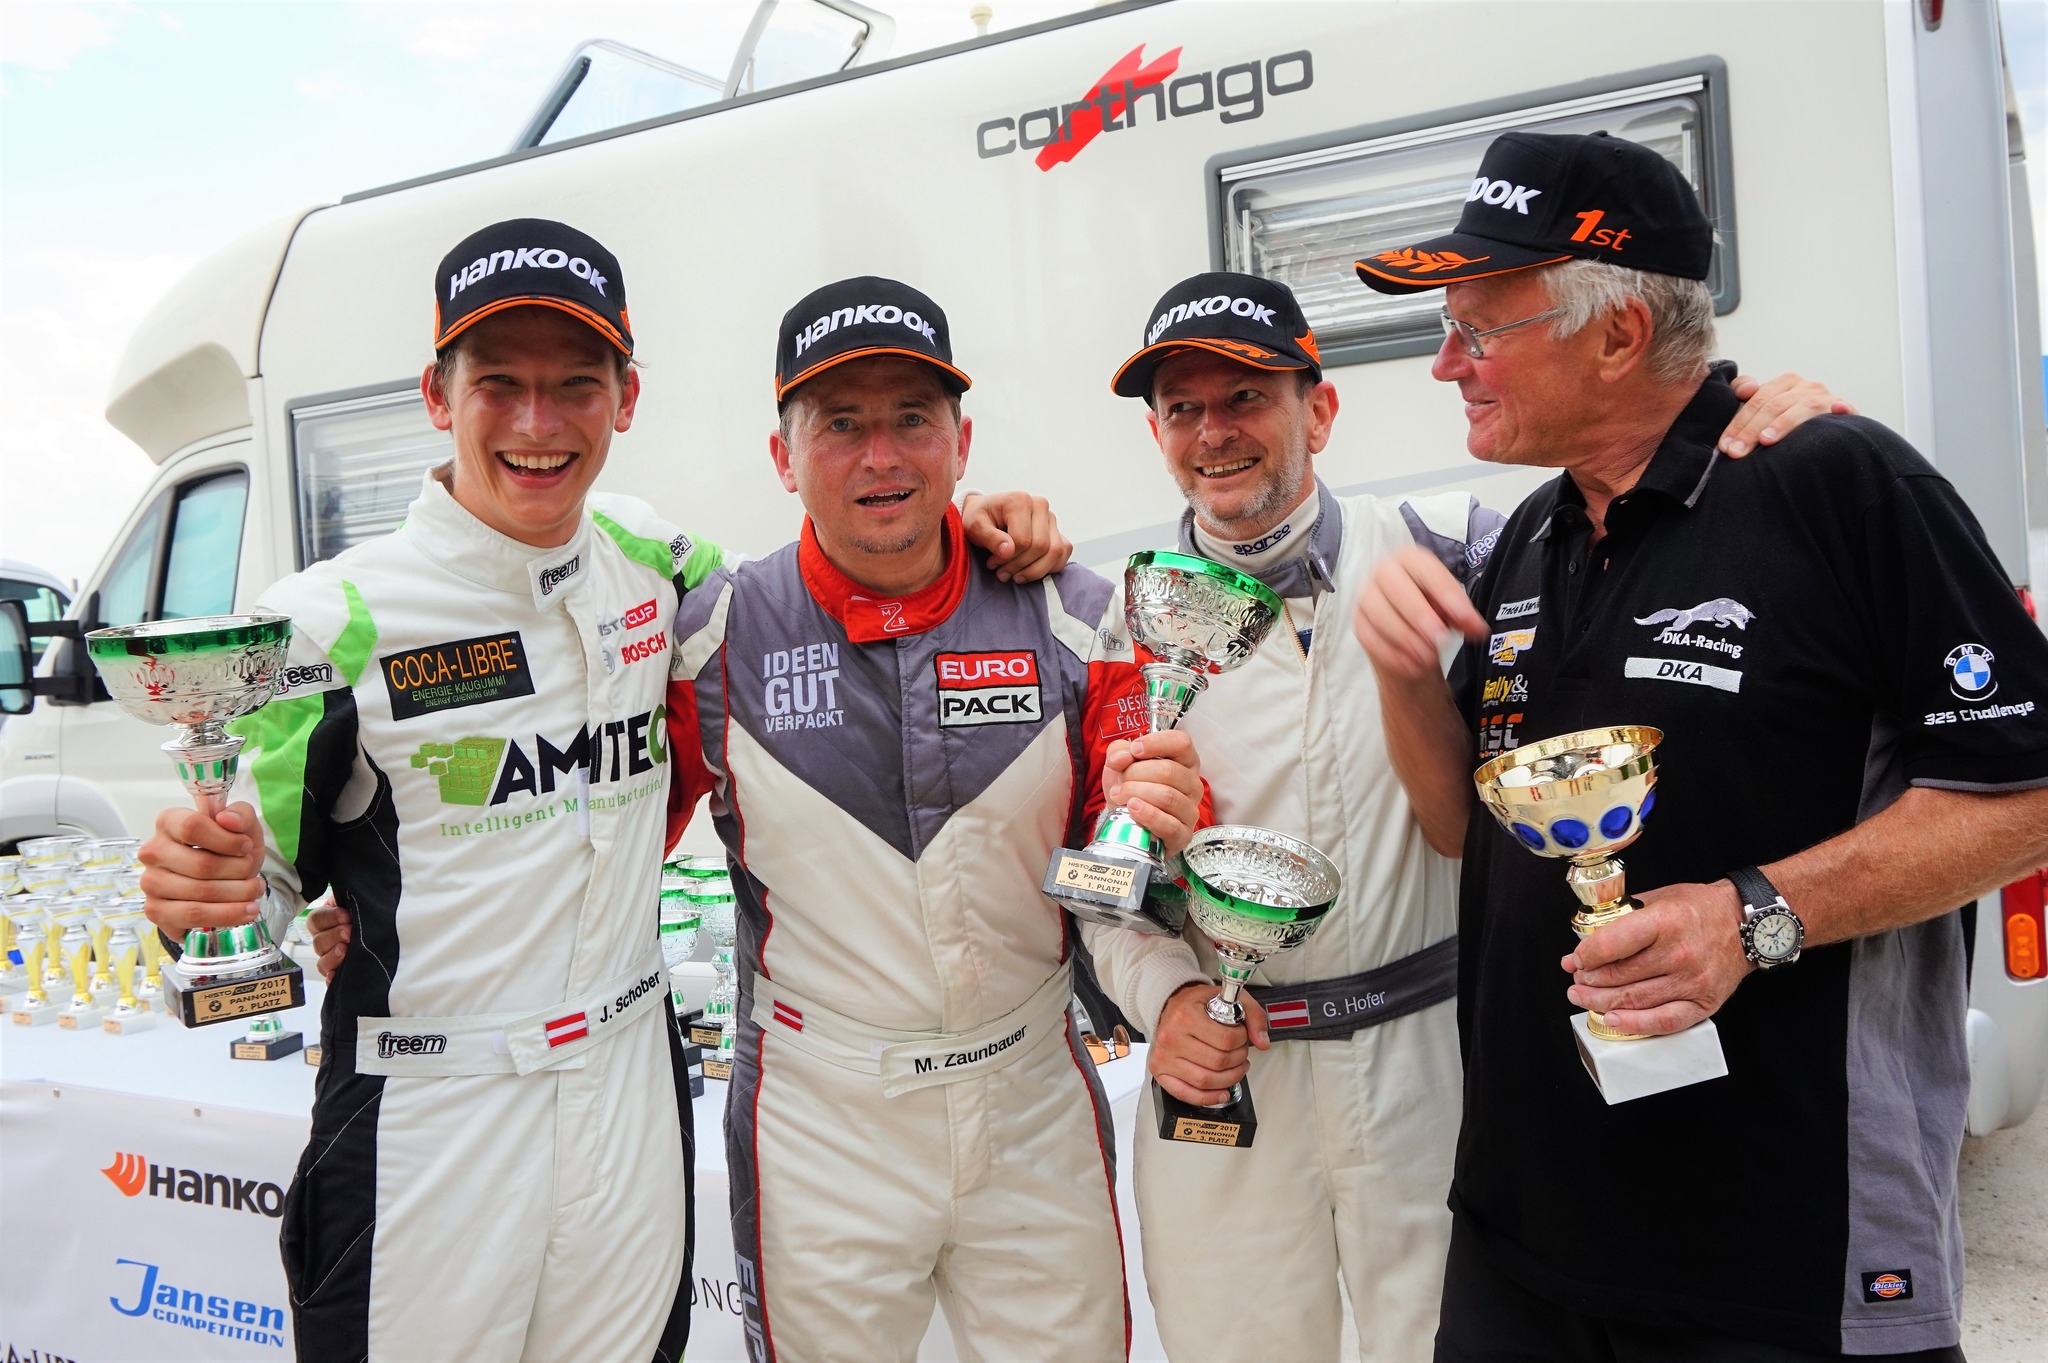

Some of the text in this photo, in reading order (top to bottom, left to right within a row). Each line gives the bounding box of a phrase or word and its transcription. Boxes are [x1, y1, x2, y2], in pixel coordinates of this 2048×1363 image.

[977, 49, 1314, 159] carthago
[1571, 210, 1632, 251] 1st
[1233, 524, 1291, 556] sparco
[540, 555, 580, 594] freem
[627, 605, 654, 625] CUP
[621, 631, 667, 664] BOSCH
[1662, 632, 1743, 659] DKA-Racing
[1946, 645, 1993, 667] BMW
[390, 639, 518, 690] COCA-LIBRE
[763, 642, 839, 679] IDEEN
[941, 658, 1030, 681] EURO
[1657, 661, 1703, 681] DKA
[412, 674, 507, 701] ENERGIE KAUGUMMI
[425, 687, 498, 708] ENERGY CHEWING GUM
[765, 669, 840, 717] GUT
[944, 694, 1035, 718] PACK
[1924, 700, 2035, 725] 325 Challenge
[765, 710, 844, 733] VERPACKT
[440, 776, 665, 836] Intelligent Manufacturin
[1084, 873, 1129, 886] PANNONIA
[1111, 868, 1132, 878] 2017
[1097, 884, 1121, 894] PLATZ
[204, 990, 232, 1000] HISTO
[261, 978, 287, 990] 2017
[230, 989, 287, 1005] PANNONIA
[600, 971, 660, 1024] J. Schober
[238, 998, 281, 1013] 2. PLATZ
[1323, 991, 1386, 1017] G. Hofer
[379, 1033, 445, 1057] freem
[914, 1025, 1027, 1074] M. Zaunbauer
[1196, 1130, 1235, 1138] PANNONIA
[1208, 1136, 1229, 1144] PLATZ
[110, 1258, 284, 1331] Jansen
[1873, 1281, 1905, 1291] Dickies
[152, 1308, 284, 1348] COMPETITION
